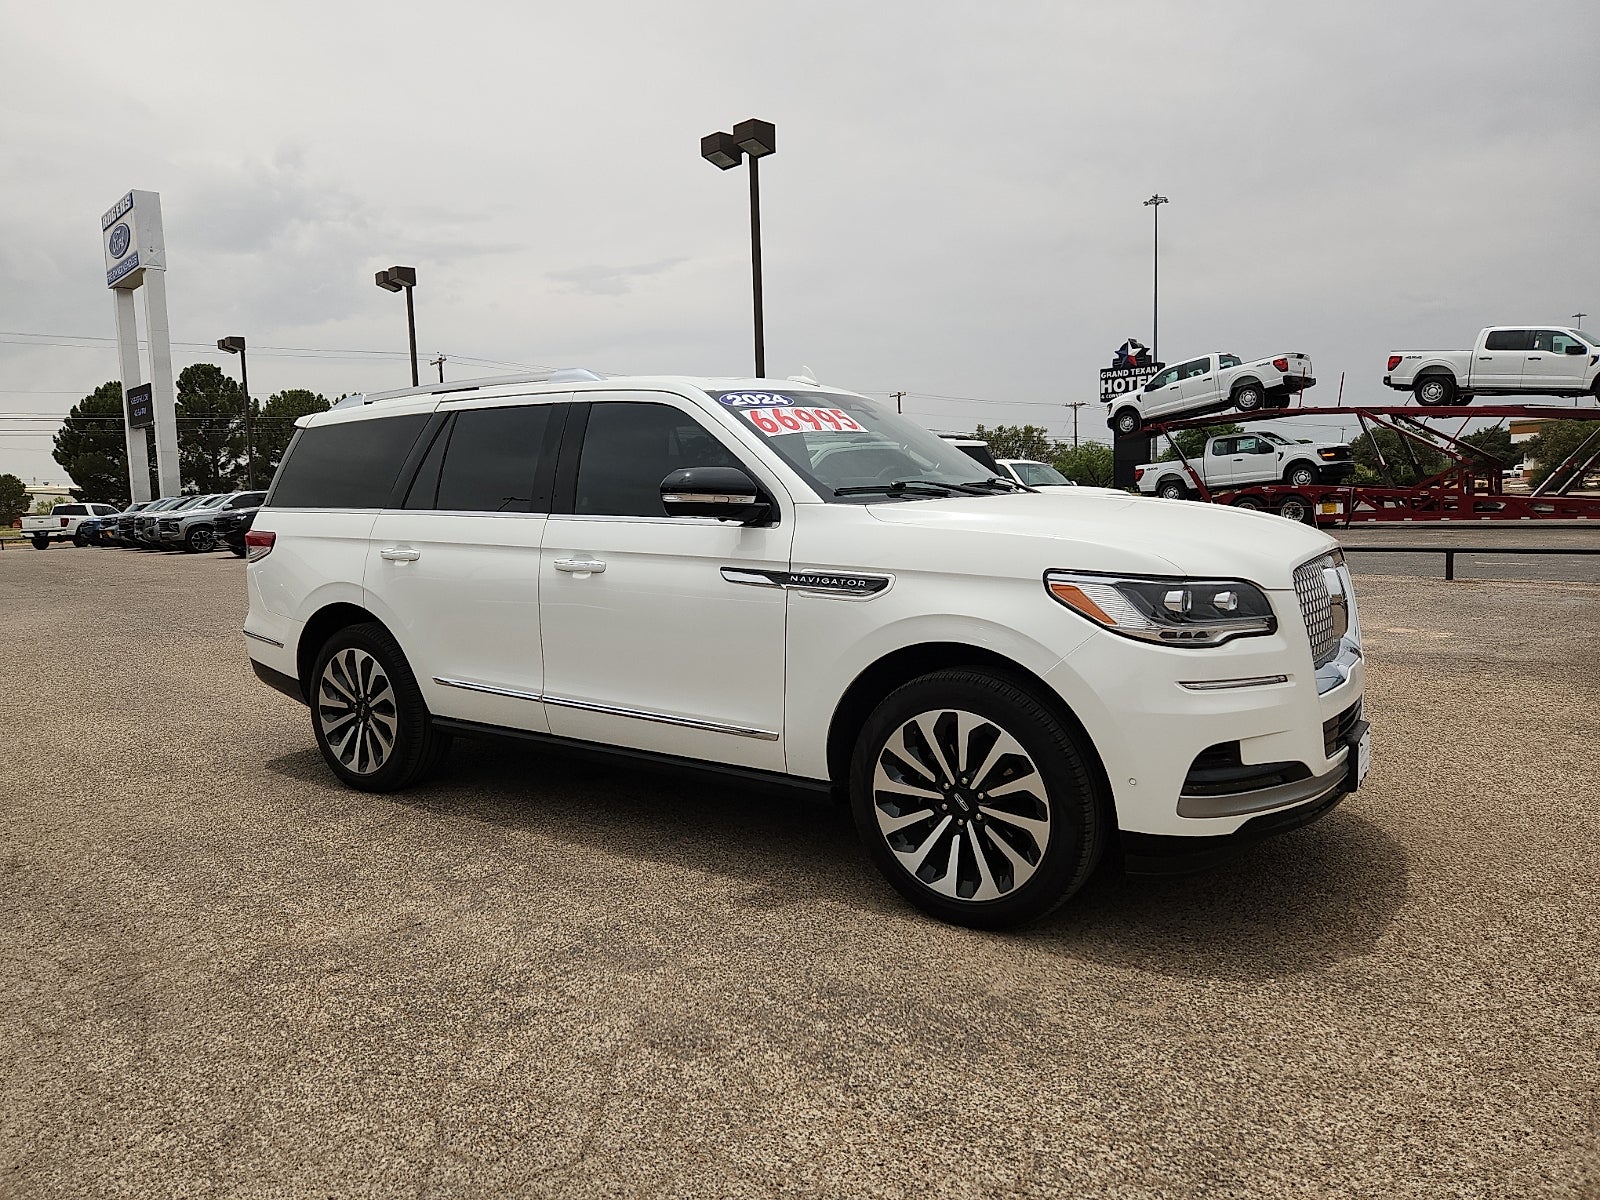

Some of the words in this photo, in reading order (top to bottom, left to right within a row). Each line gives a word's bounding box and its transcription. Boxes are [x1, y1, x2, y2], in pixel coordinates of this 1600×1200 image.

[1101, 370, 1129, 379] GRAND
[1131, 366, 1157, 375] TEXAN
[727, 393, 789, 406] 2024
[750, 408, 858, 433] 66995
[790, 574, 867, 588] NAVIGATOR
